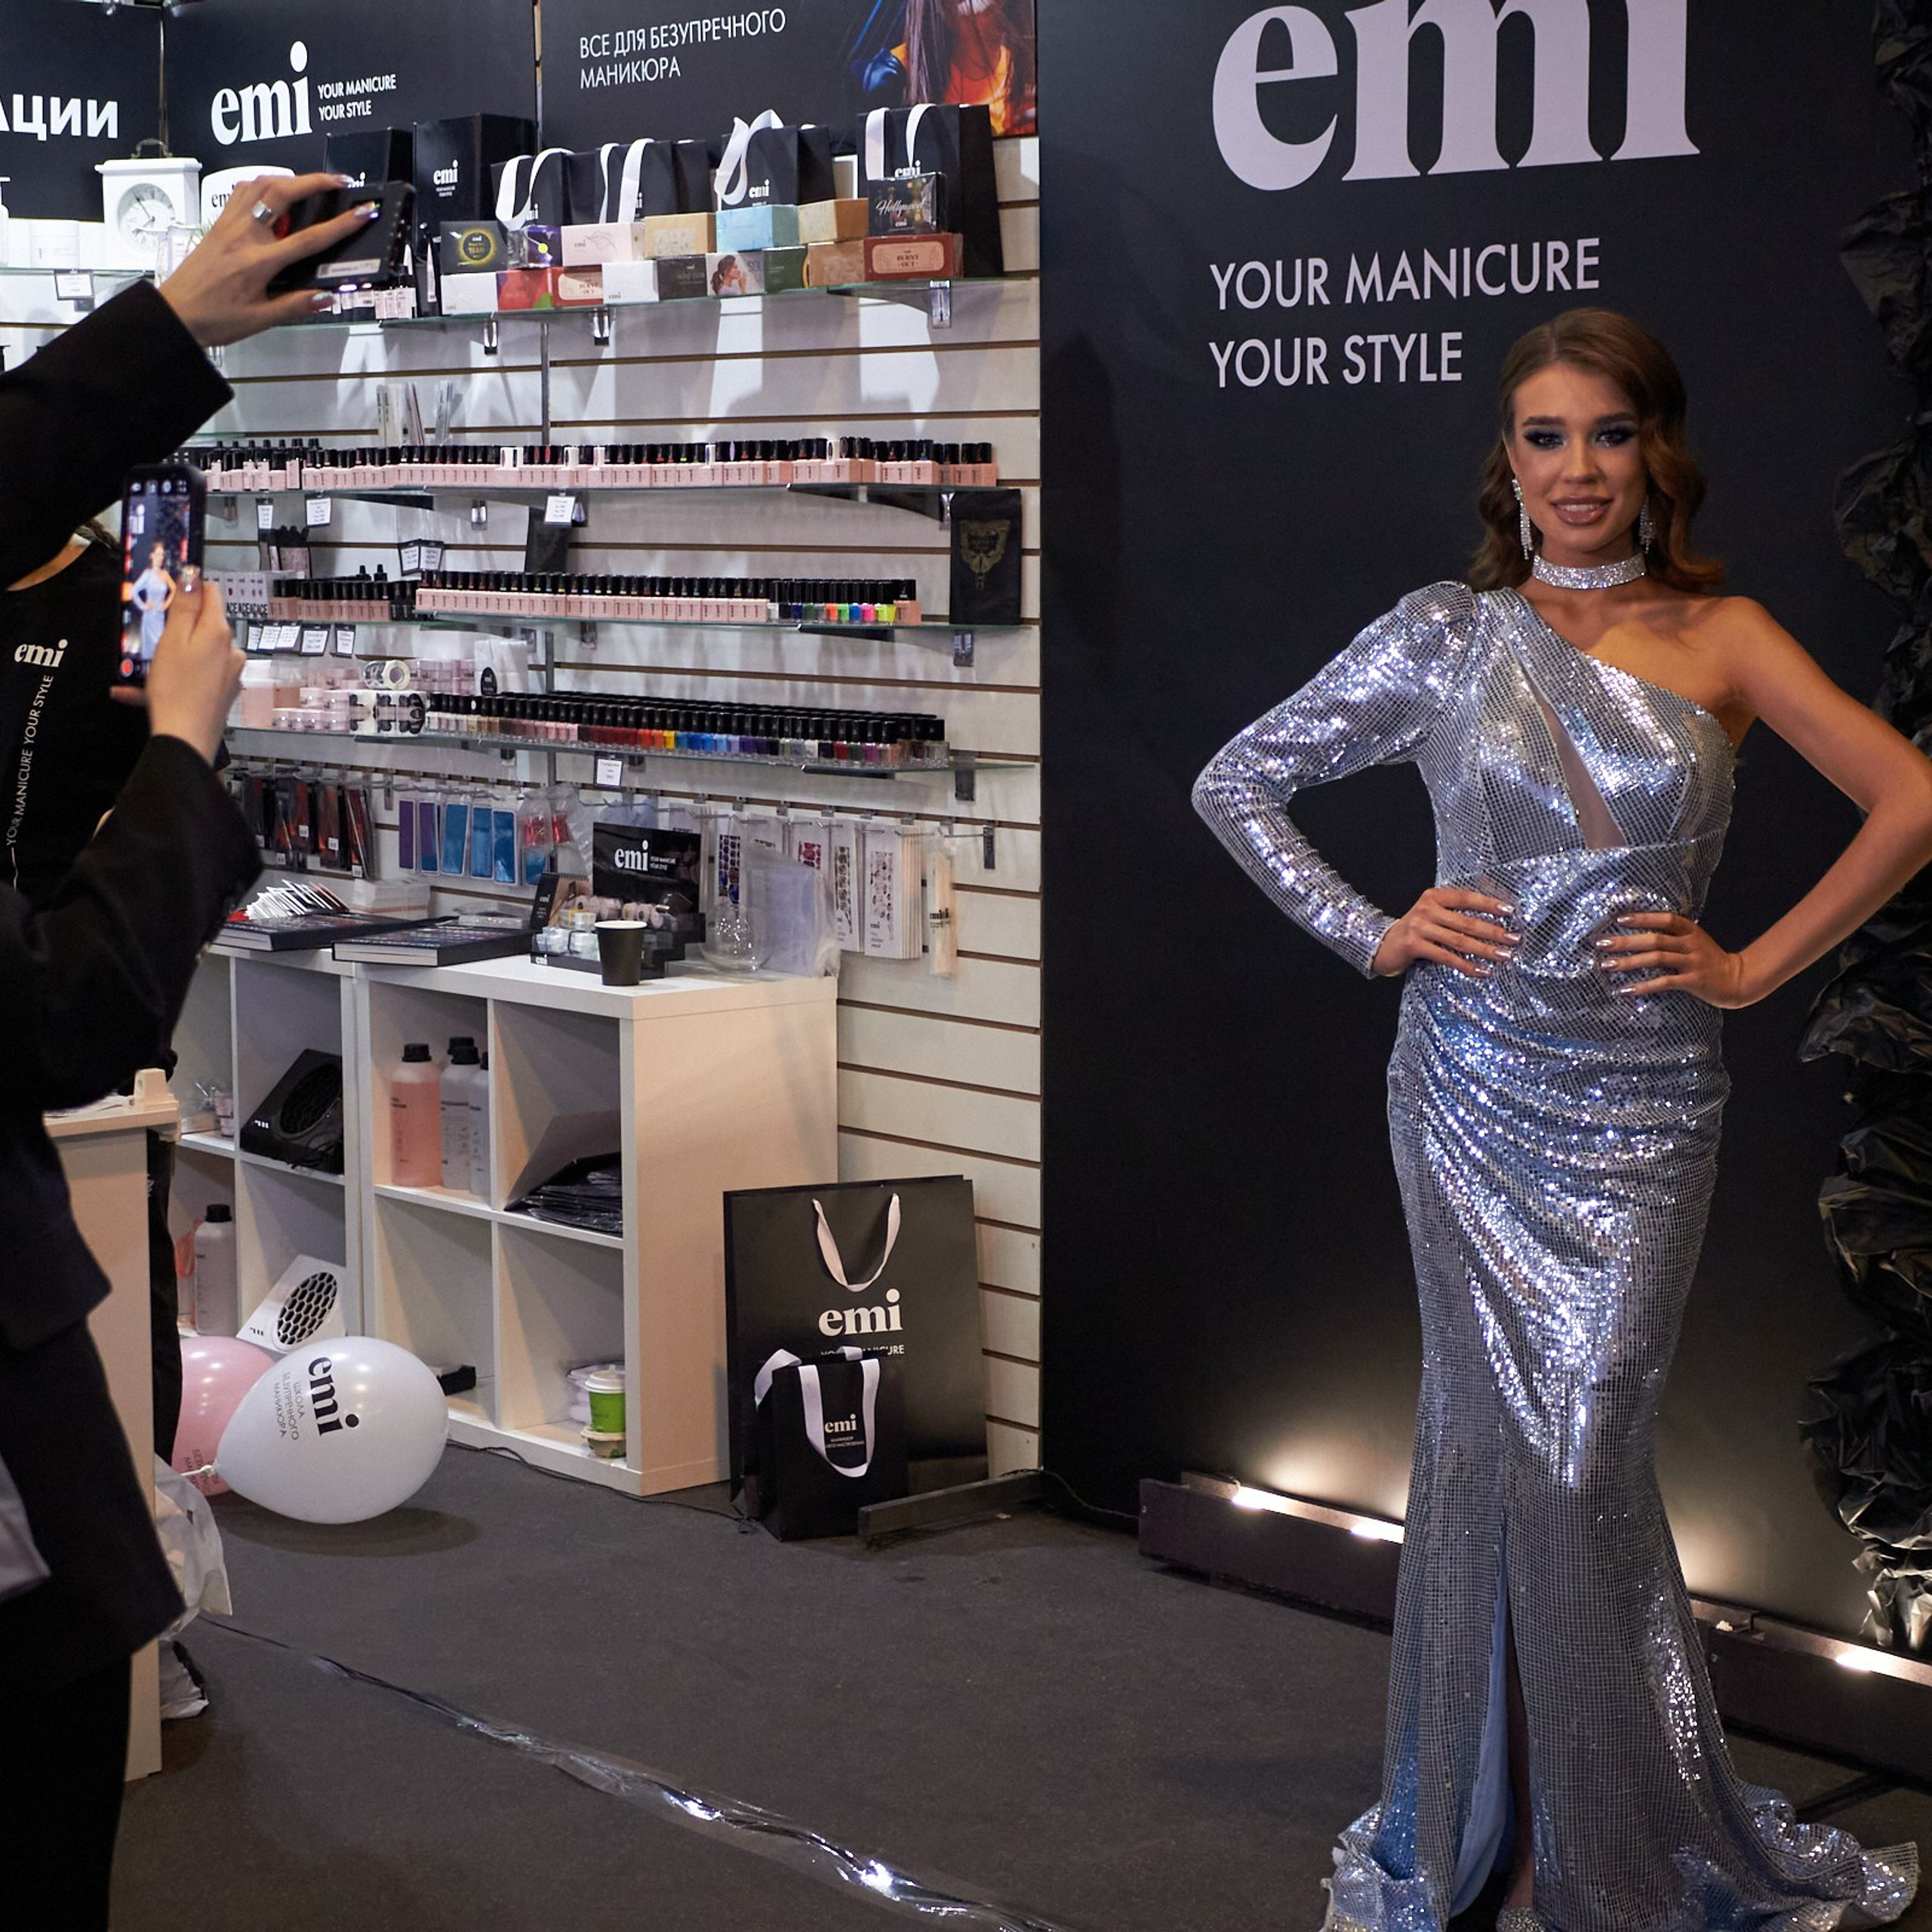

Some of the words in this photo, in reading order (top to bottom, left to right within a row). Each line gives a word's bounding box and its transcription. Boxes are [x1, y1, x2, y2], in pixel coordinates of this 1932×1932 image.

[580, 34, 610, 59] ВСЕ
[614, 29, 646, 57] ДЛЯ
[651, 8, 786, 49] БЕЗУПРЕЧНОГО
[318, 81, 344, 100] YOUR
[346, 74, 397, 96] MANICURE
[580, 56, 681, 89] МАНИКЮРА
[211, 41, 312, 145] emi
[318, 105, 346, 122] YOUR
[346, 100, 372, 118] STYLE
[433, 159, 458, 185] emi
[1210, 257, 1331, 310] YOUR
[1345, 238, 1600, 305] MANICURE
[1209, 337, 1329, 388] YOUR
[1342, 331, 1463, 384] STYLE
[14, 638, 68, 667] emi
[32, 675, 54, 708] STYLE
[23, 709, 42, 745] YOUR
[14, 749, 34, 816] MANICURE
[6, 817, 23, 847] YOUR
[615, 839, 648, 871] emi
[818, 1288, 903, 1337] emi
[274, 1382, 288, 1438] МАНИКЮРА
[293, 1382, 305, 1419] ШКОЛА
[308, 1357, 359, 1436] emi
[824, 1414, 857, 1433] emi
